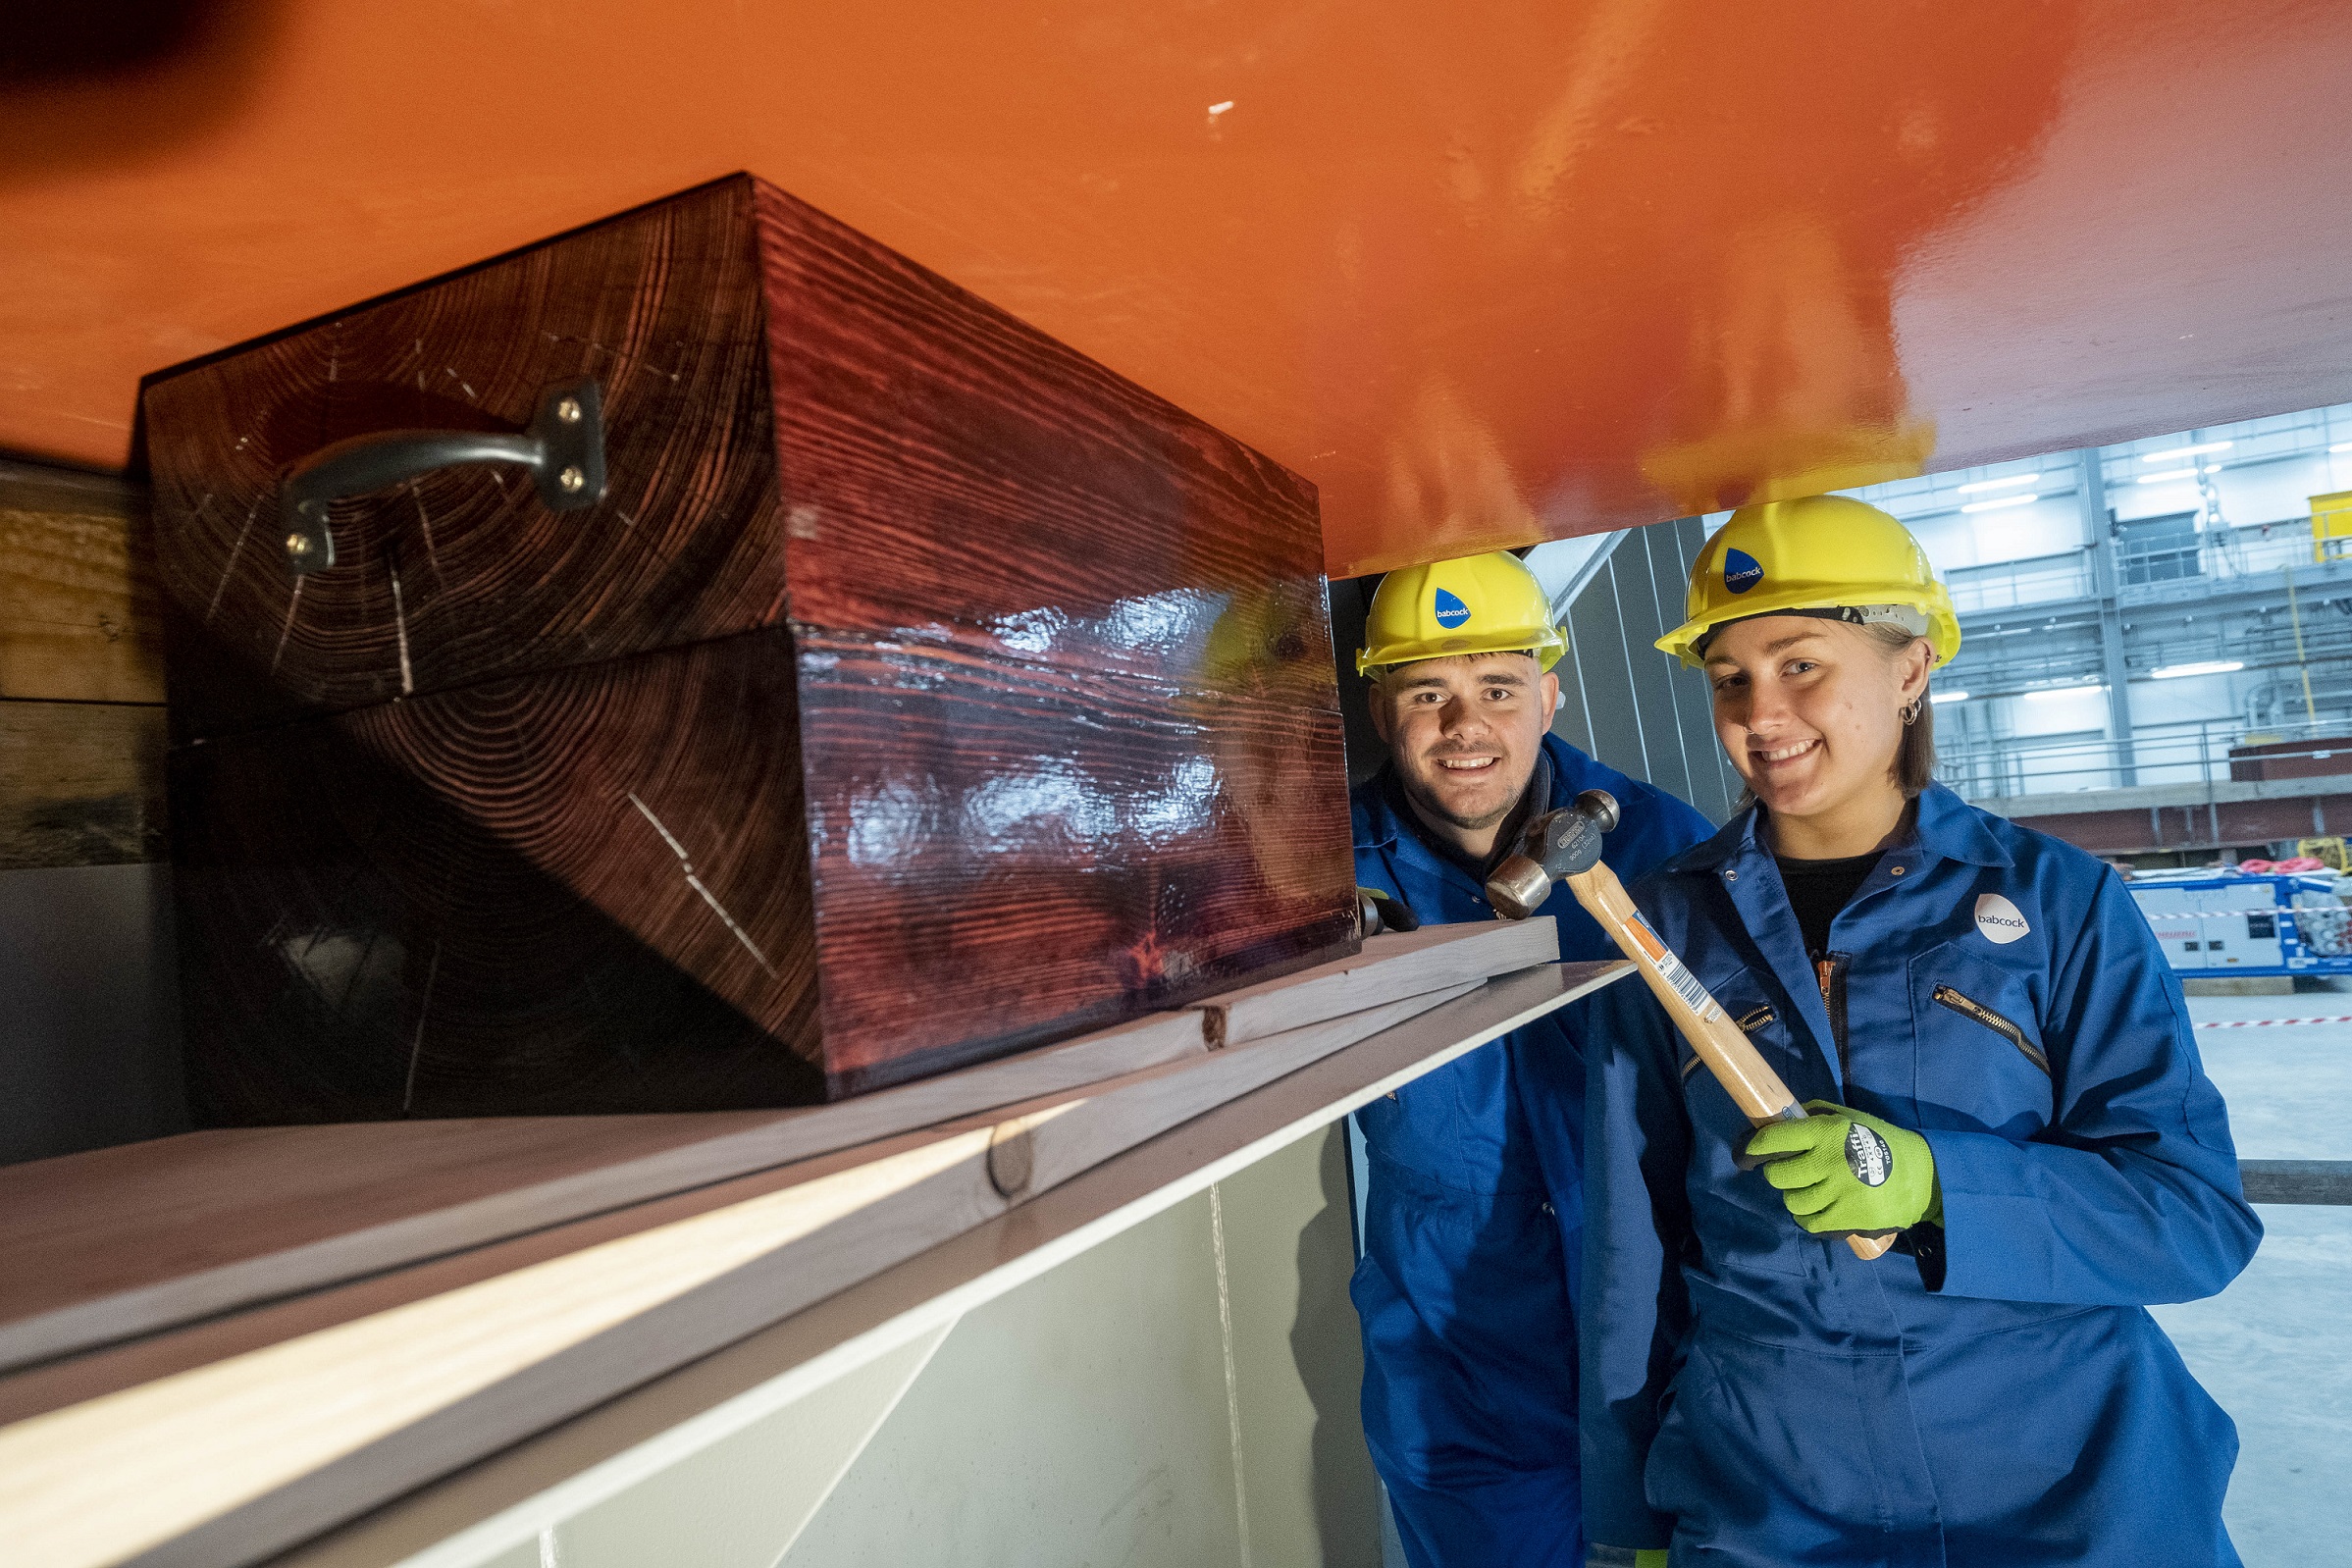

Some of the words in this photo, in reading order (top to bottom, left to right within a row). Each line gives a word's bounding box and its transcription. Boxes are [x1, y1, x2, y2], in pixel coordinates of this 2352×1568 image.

[1726, 566, 1761, 583] babcock
[1437, 607, 1469, 618] babcock
[1977, 915, 2025, 928] babcock
[1850, 1133, 1868, 1178] Traffi
